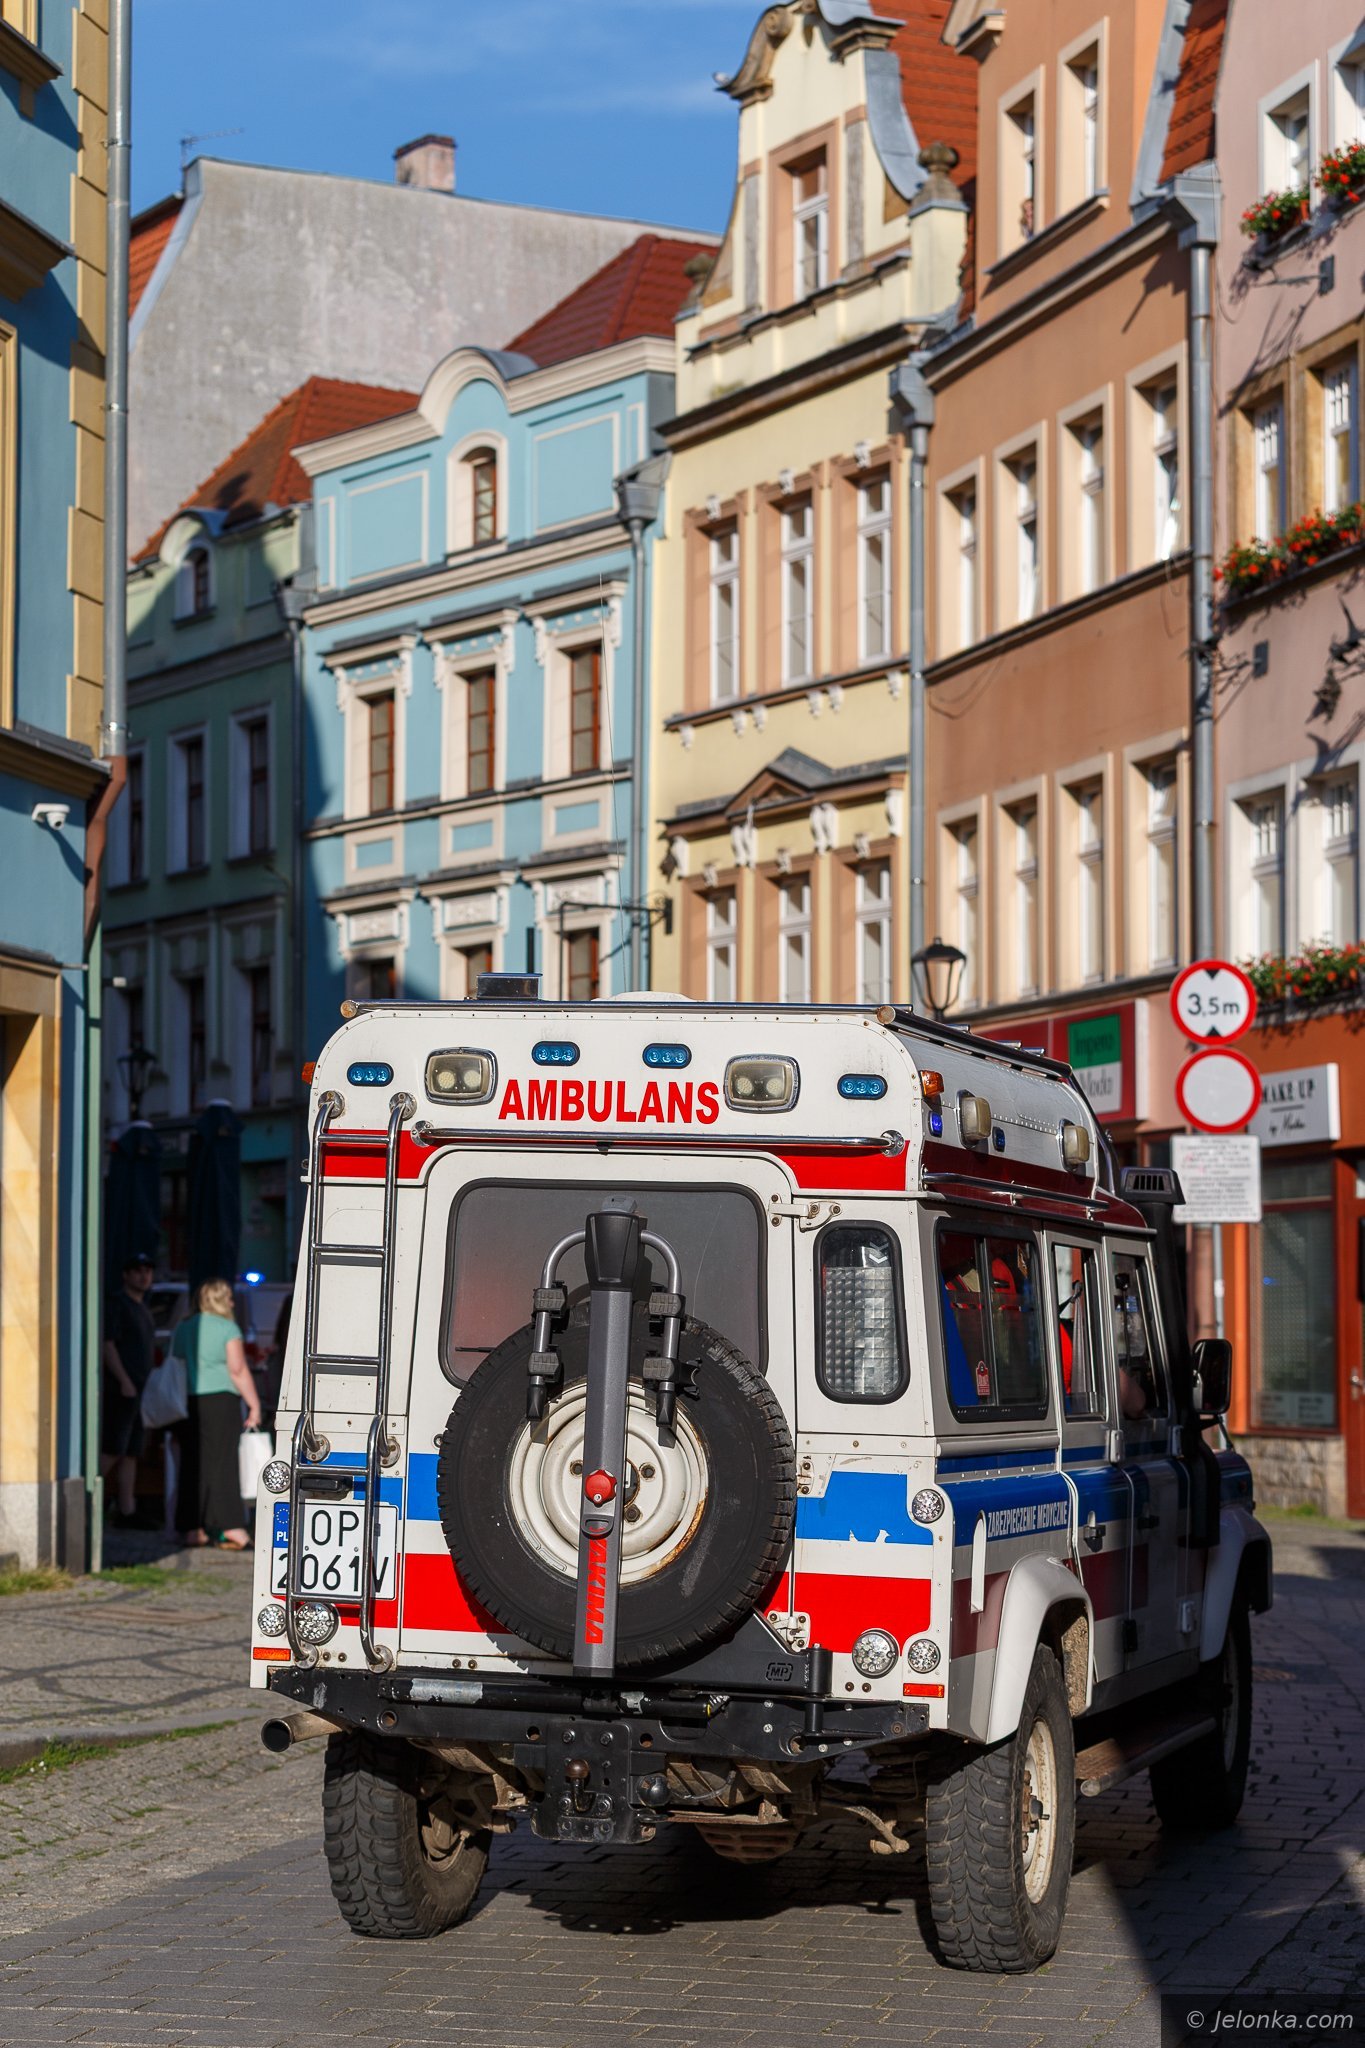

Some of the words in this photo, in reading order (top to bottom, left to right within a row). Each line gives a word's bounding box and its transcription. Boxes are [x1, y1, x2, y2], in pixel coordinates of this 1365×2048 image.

[498, 1079, 720, 1125] AMBULANS
[1298, 1078, 1315, 1100] UP
[311, 1509, 360, 1547] OP
[987, 1505, 1037, 1538] ZABEZPIECZENIE
[1037, 1500, 1068, 1529] MEDYCZNE
[276, 1531, 289, 1542] PL
[770, 1666, 789, 1677] MP
